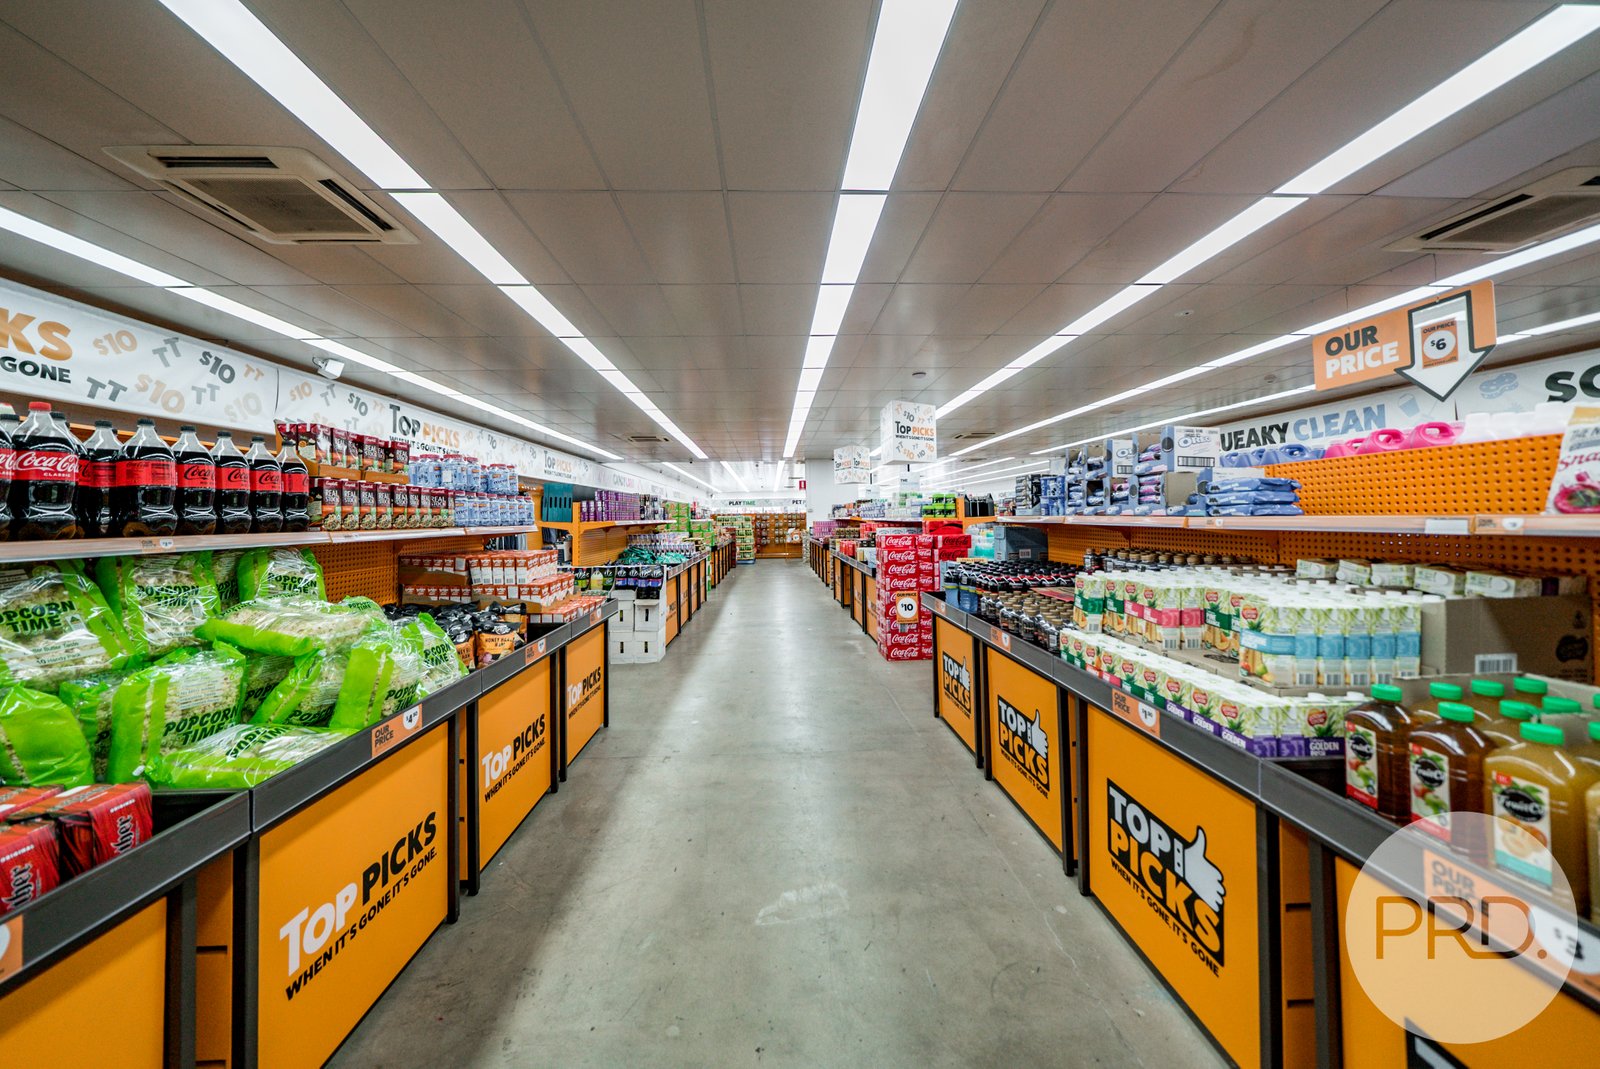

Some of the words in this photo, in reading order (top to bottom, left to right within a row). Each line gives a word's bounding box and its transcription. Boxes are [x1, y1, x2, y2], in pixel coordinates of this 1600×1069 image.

[92, 330, 138, 356] $10
[152, 337, 181, 367] TT
[1325, 325, 1379, 357] OUR
[1430, 338, 1447, 350] $6
[0, 356, 71, 383] GONE
[199, 351, 236, 384] $10
[1326, 341, 1400, 379] PRICE
[86, 376, 128, 402] TT
[134, 374, 185, 414] $10
[191, 383, 220, 405] TT
[290, 381, 312, 401] $10
[347, 393, 368, 416] $10
[389, 404, 421, 437] TOP
[895, 420, 911, 434] TOP
[912, 426, 934, 437] PICKS
[1220, 421, 1289, 452] UEAKY
[1293, 404, 1386, 441] CLEAN
[886, 536, 912, 546] Coca-Cola
[888, 550, 915, 560] Coca-Cola
[888, 564, 916, 575] Coca-Cola
[282, 581, 309, 594] TIME
[890, 578, 917, 588] Coca-Cola
[0, 601, 76, 623] PCORN
[901, 603, 914, 611] $10
[6, 614, 61, 633] TIME
[892, 633, 919, 644] Coca-Cola
[890, 646, 919, 658] Coca-Cola
[944, 654, 960, 679] TOP
[567, 682, 583, 708] TOP
[582, 666, 601, 695] PICKS
[944, 671, 971, 710] PICKS
[163, 705, 240, 737] POPCORN
[999, 699, 1027, 737] TOP
[374, 730, 394, 748] PRICE
[375, 725, 390, 738] OUR
[482, 744, 512, 789] TOP
[513, 713, 546, 761] PICKS
[1000, 721, 1048, 785] PICKS
[1309, 741, 1340, 751] GOLDEN
[484, 779, 503, 803] WHEN
[502, 770, 512, 786] IT'S
[511, 757, 526, 776] GONE
[1109, 786, 1172, 858] TOP
[1110, 818, 1221, 953] PICKS
[1432, 861, 1475, 889] OUR
[280, 882, 358, 977] TOP
[361, 811, 437, 907] PICKS
[1111, 859, 1131, 885] WHEN
[1132, 882, 1146, 901] IT'S
[1172, 922, 1188, 944] IT'S
[285, 946, 333, 1000] WHEN
[334, 923, 358, 955] IT'S
[358, 890, 392, 930] GONE
[392, 872, 409, 898] IT'S
[410, 846, 438, 879] GONE.
